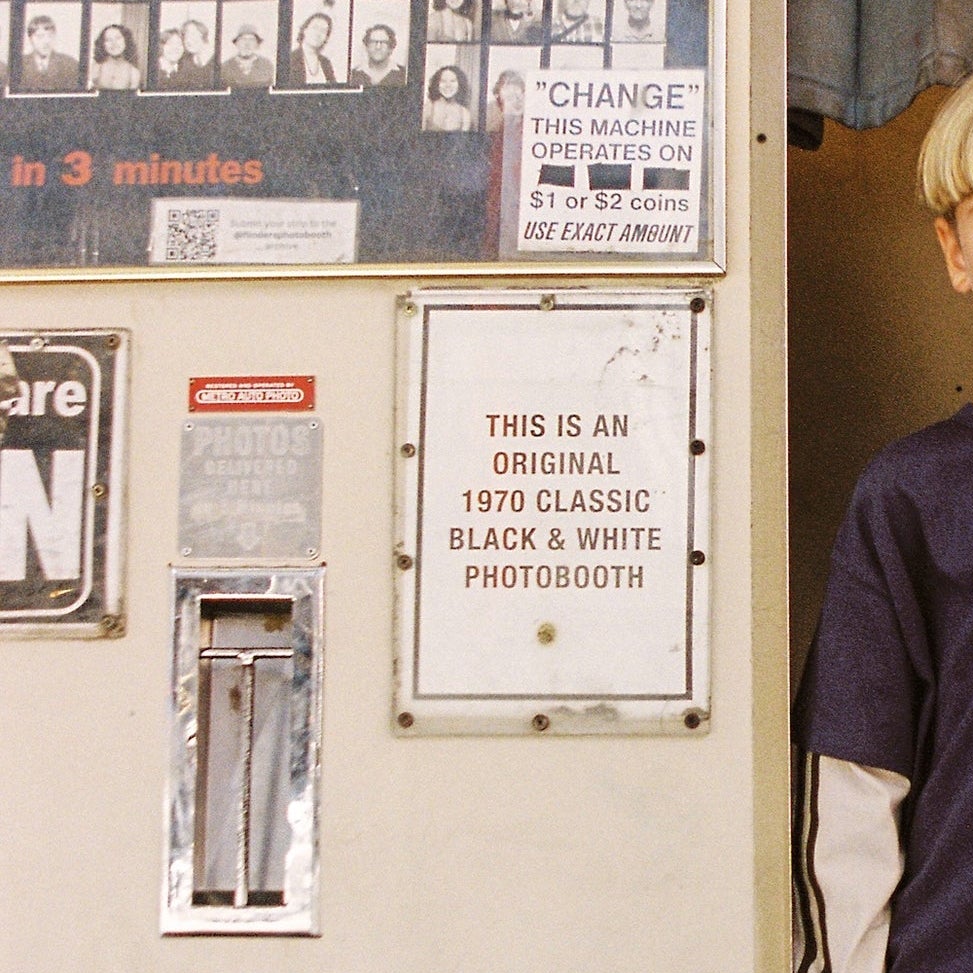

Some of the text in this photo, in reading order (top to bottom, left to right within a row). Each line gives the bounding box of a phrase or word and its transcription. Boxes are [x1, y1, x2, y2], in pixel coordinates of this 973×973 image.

[530, 118, 696, 138] THIS MACHINE
[531, 142, 693, 162] OPERATES ON
[11, 150, 264, 187] in 3 minutes
[530, 190, 690, 212] $1 or $2 coins
[524, 221, 695, 243] USE EXACT AMOUNT
[486, 414, 629, 438] THIS IS AN
[493, 451, 621, 475] ORIGINAL
[462, 489, 651, 513] 1970 CLASSIC
[449, 527, 662, 551] BLACK & WHITE
[465, 565, 644, 589] PHOTOBOOTH
